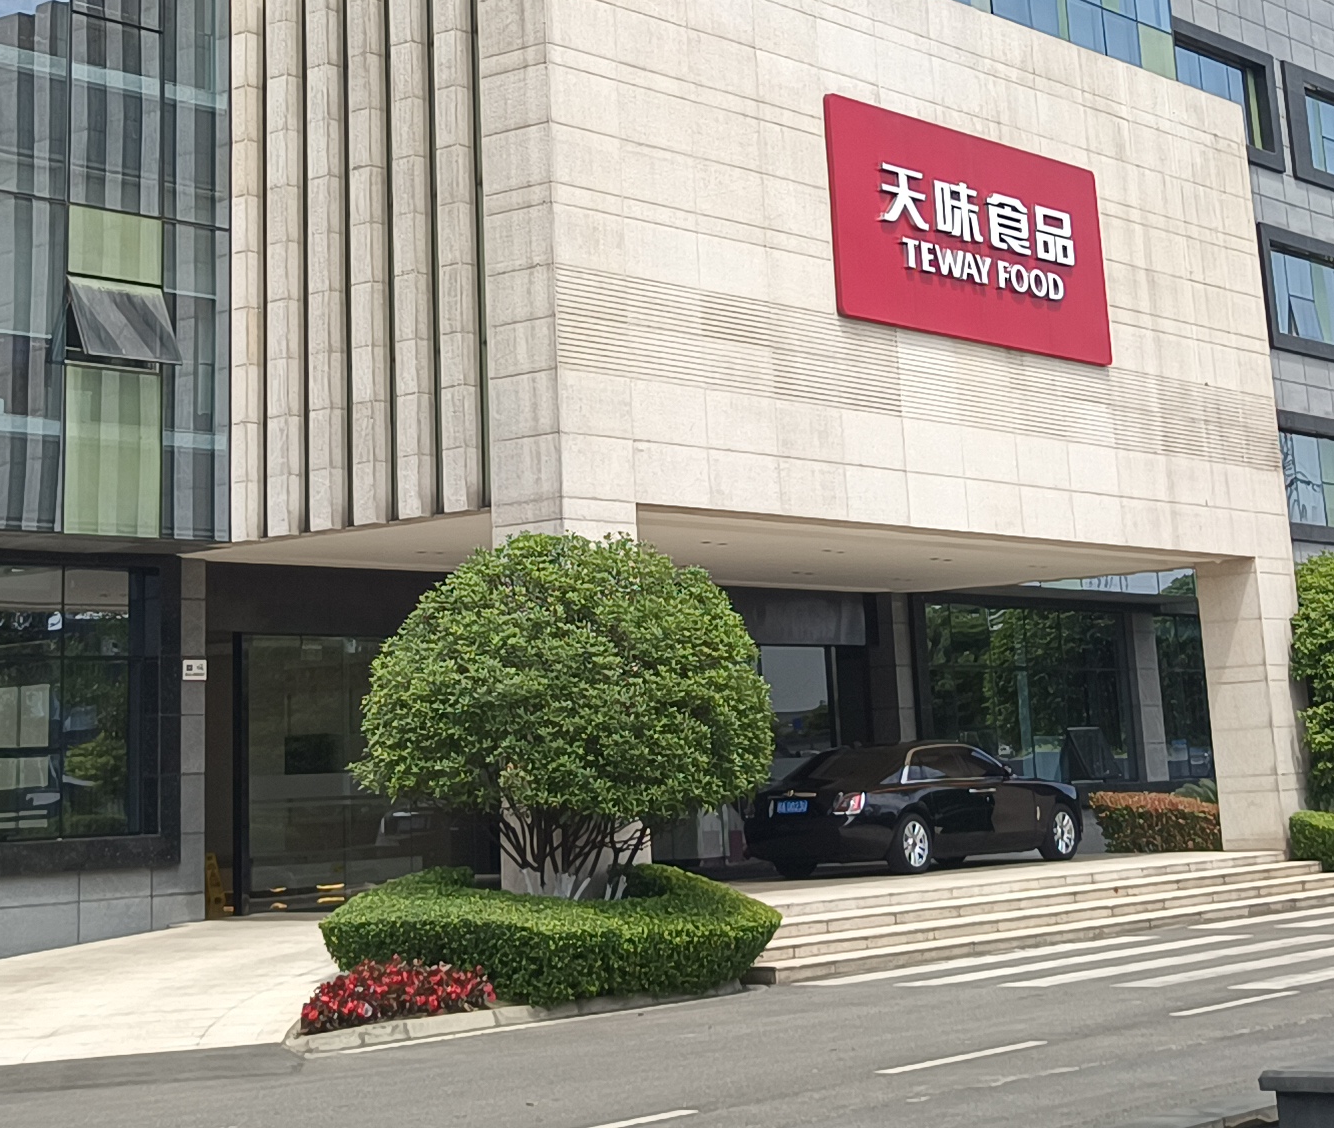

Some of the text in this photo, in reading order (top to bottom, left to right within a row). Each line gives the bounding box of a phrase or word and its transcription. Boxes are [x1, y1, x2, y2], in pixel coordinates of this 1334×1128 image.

[879, 161, 1076, 267] 天味食品
[900, 236, 1064, 301] TEWAY FOOD
